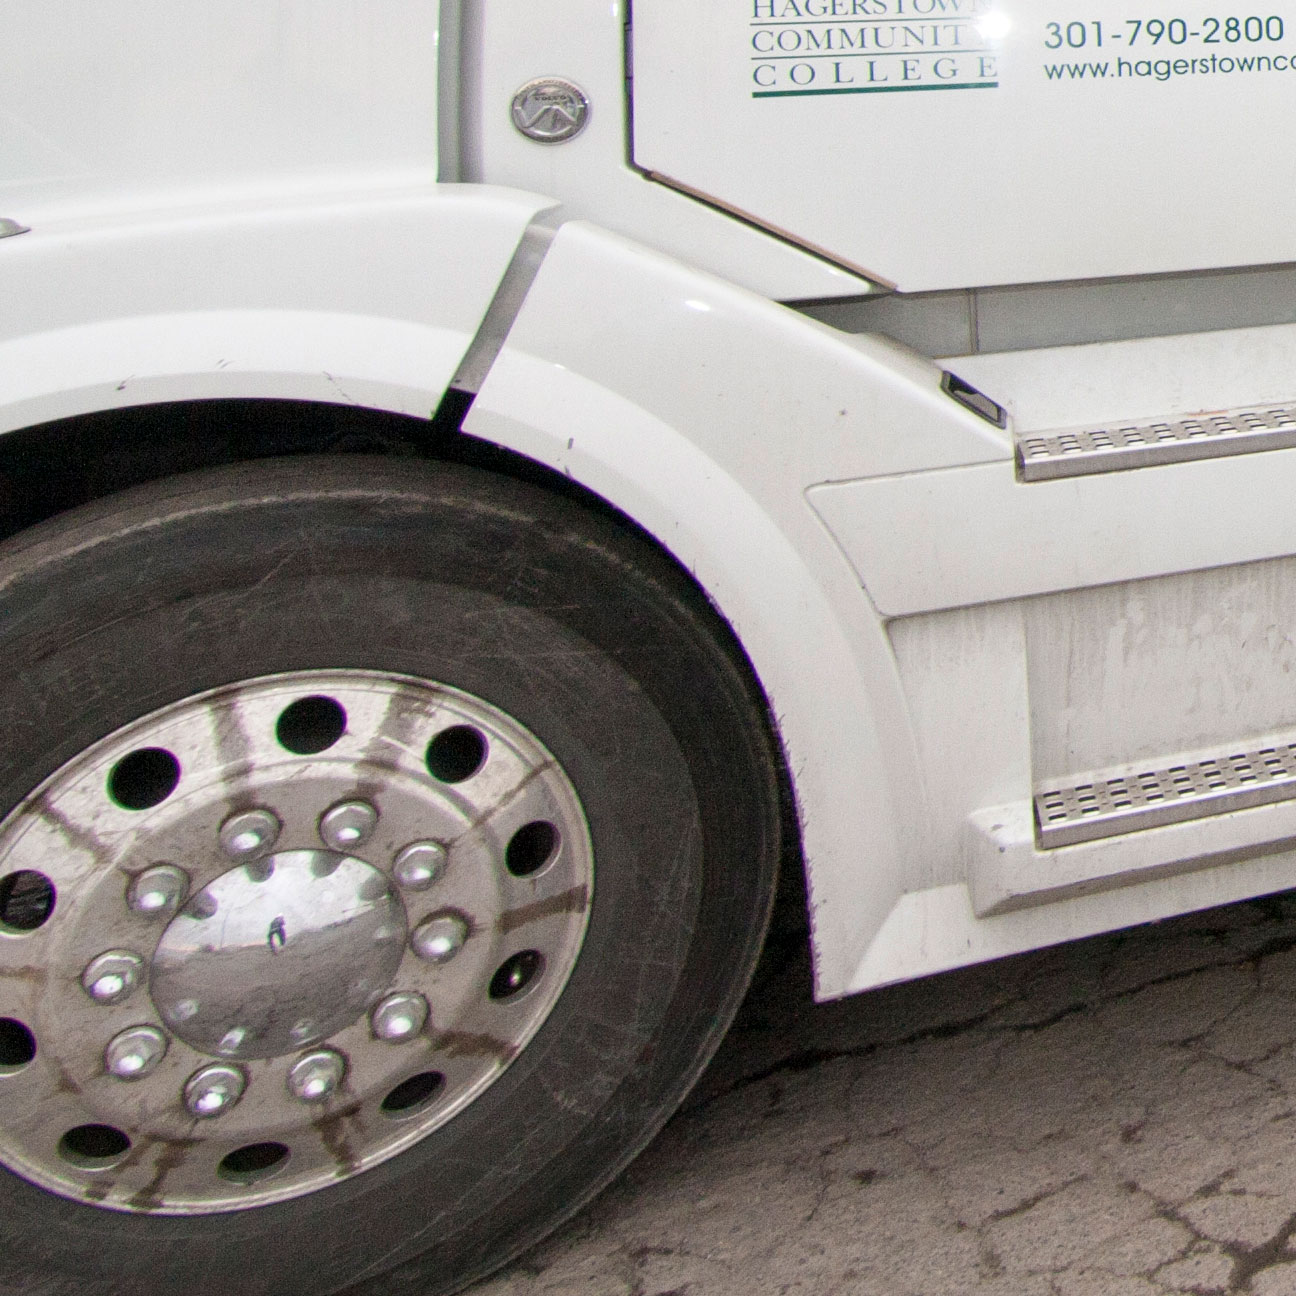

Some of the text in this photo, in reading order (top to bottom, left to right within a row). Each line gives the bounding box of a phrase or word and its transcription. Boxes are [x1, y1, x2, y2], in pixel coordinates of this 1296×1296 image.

[751, 24, 990, 53] COMMUNIT
[1044, 15, 1285, 51] 301-790-2800
[752, 55, 998, 87] COLLEGE
